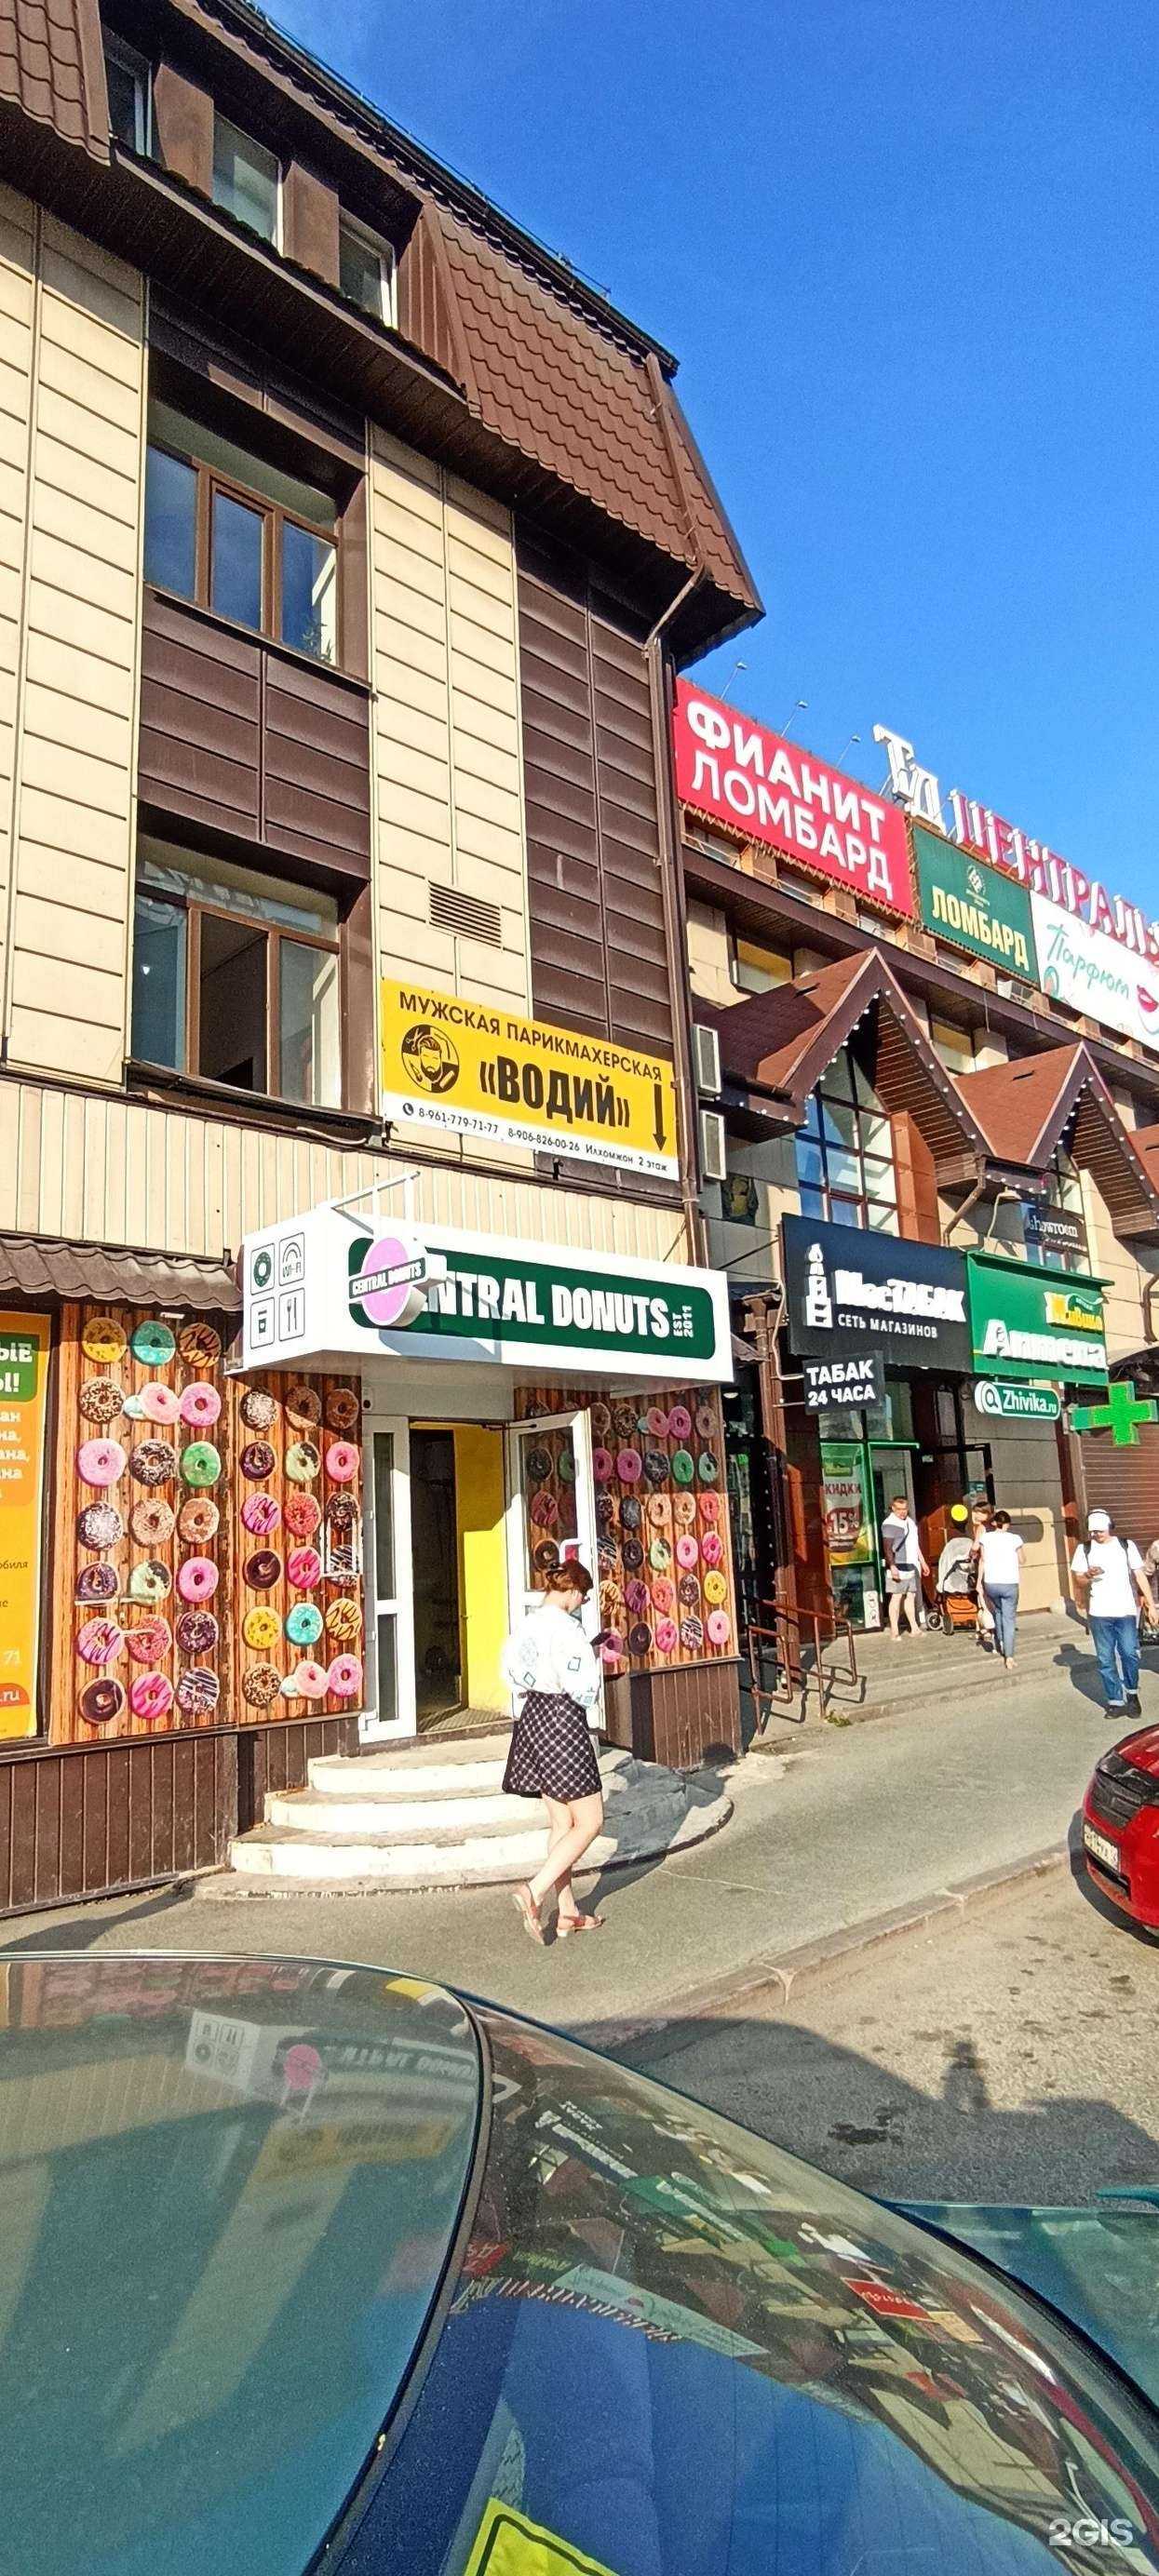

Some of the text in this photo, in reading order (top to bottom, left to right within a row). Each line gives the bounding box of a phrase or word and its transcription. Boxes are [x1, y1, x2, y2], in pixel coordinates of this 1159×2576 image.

[687, 701, 885, 843] ФИАНИТ
[692, 750, 894, 901] ЛОМБАРД
[932, 885, 1030, 972] ЛОМБАРД
[1046, 923, 1129, 1000] Парфюм
[399, 991, 663, 1081] МУЖСКАЯ ПАРИКМАХЕРСКАЯ
[479, 1055, 630, 1128] «ВОДИЙ»
[418, 1107, 668, 1172] 8-961-779-71-77 8-906-826-00-26 Илхомжон 2 этаж
[352, 1262, 422, 1295] CENTRAL DONUTS
[419, 1269, 669, 1338] NTRAL DONUTS
[672, 1312, 683, 1337] EST
[681, 1305, 694, 1338] 2011
[838, 1314, 937, 1338] СЕТЬ МАГАЗИНОВ
[806, 1360, 874, 1386] ТАБАК
[808, 1384, 876, 1406] 24 ЧАСА
[1003, 1389, 1058, 1414] Zhivika.ru
